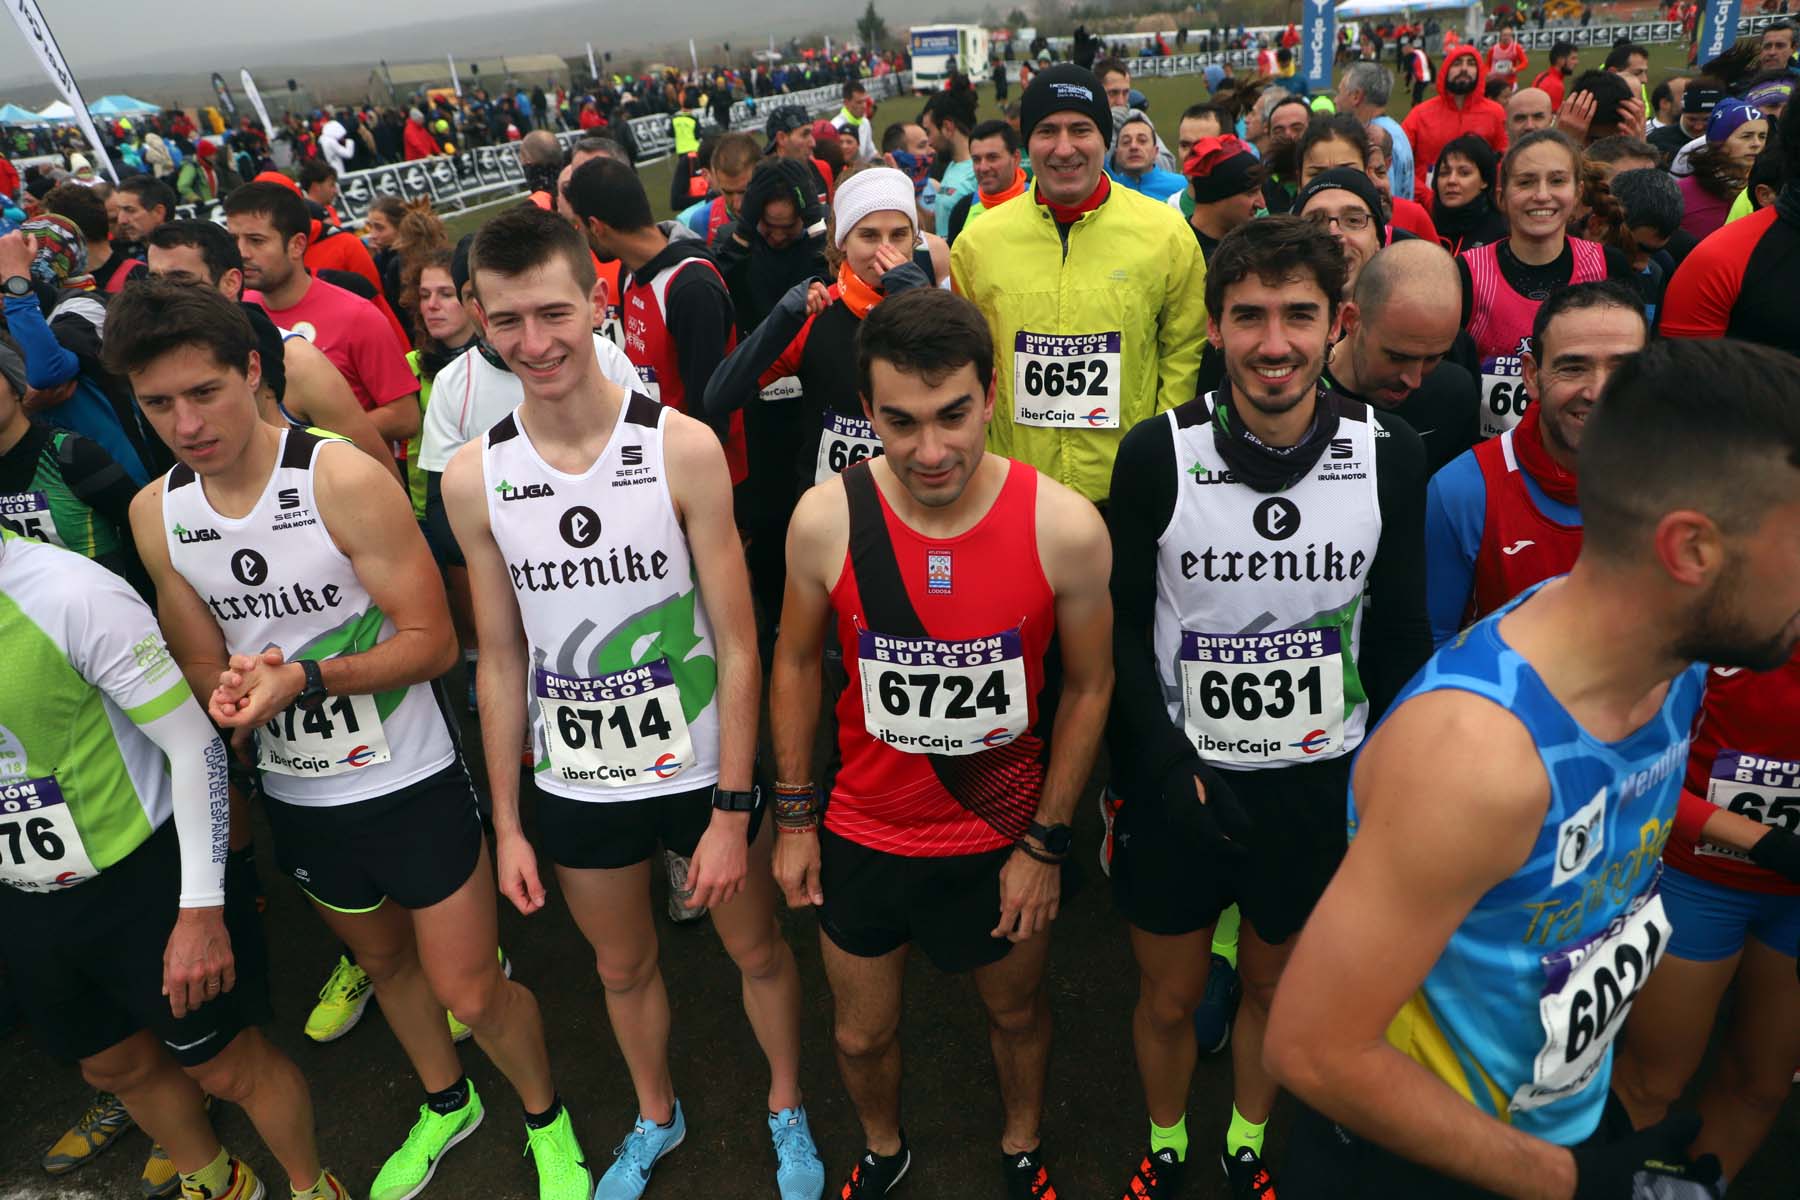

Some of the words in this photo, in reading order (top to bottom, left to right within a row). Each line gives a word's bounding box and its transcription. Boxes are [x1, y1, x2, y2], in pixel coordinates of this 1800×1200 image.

[1026, 334, 1108, 346] DIPUTACIÓN
[1026, 343, 1108, 356] BURGOS
[1024, 359, 1109, 396] 6652
[1021, 408, 1075, 423] iberCaja
[833, 423, 880, 440] BUR
[829, 439, 886, 473] 66
[615, 466, 651, 477] SEAT
[1323, 462, 1362, 471] SEAT
[632, 476, 657, 486] MOTOR
[1195, 470, 1241, 485] LUG
[1341, 472, 1367, 481] MOTOR
[502, 483, 555, 502] LUGA
[274, 509, 310, 522] SEAT
[179, 528, 222, 544] LUGA
[208, 582, 343, 621] txenike
[873, 636, 1002, 654] DIPUTACIÓN
[1196, 629, 1323, 649] DIPUTACIÓN
[875, 648, 1004, 667] BURGOS
[1198, 643, 1324, 663] BURGOS
[546, 666, 652, 690] DIPUTACIÓN
[547, 678, 656, 701] BURGOS
[878, 669, 1011, 719] 6724
[1199, 665, 1323, 721] 6631
[556, 696, 673, 750] 6714
[879, 729, 964, 752] iberCaja
[1197, 734, 1281, 757] iberCaja
[203, 746, 219, 781] COPA
[269, 750, 330, 773] iberCaja
[561, 765, 637, 782] iberCaja
[208, 782, 221, 800] DE
[0, 816, 66, 866] 76
[1565, 920, 1661, 1063] 6021
